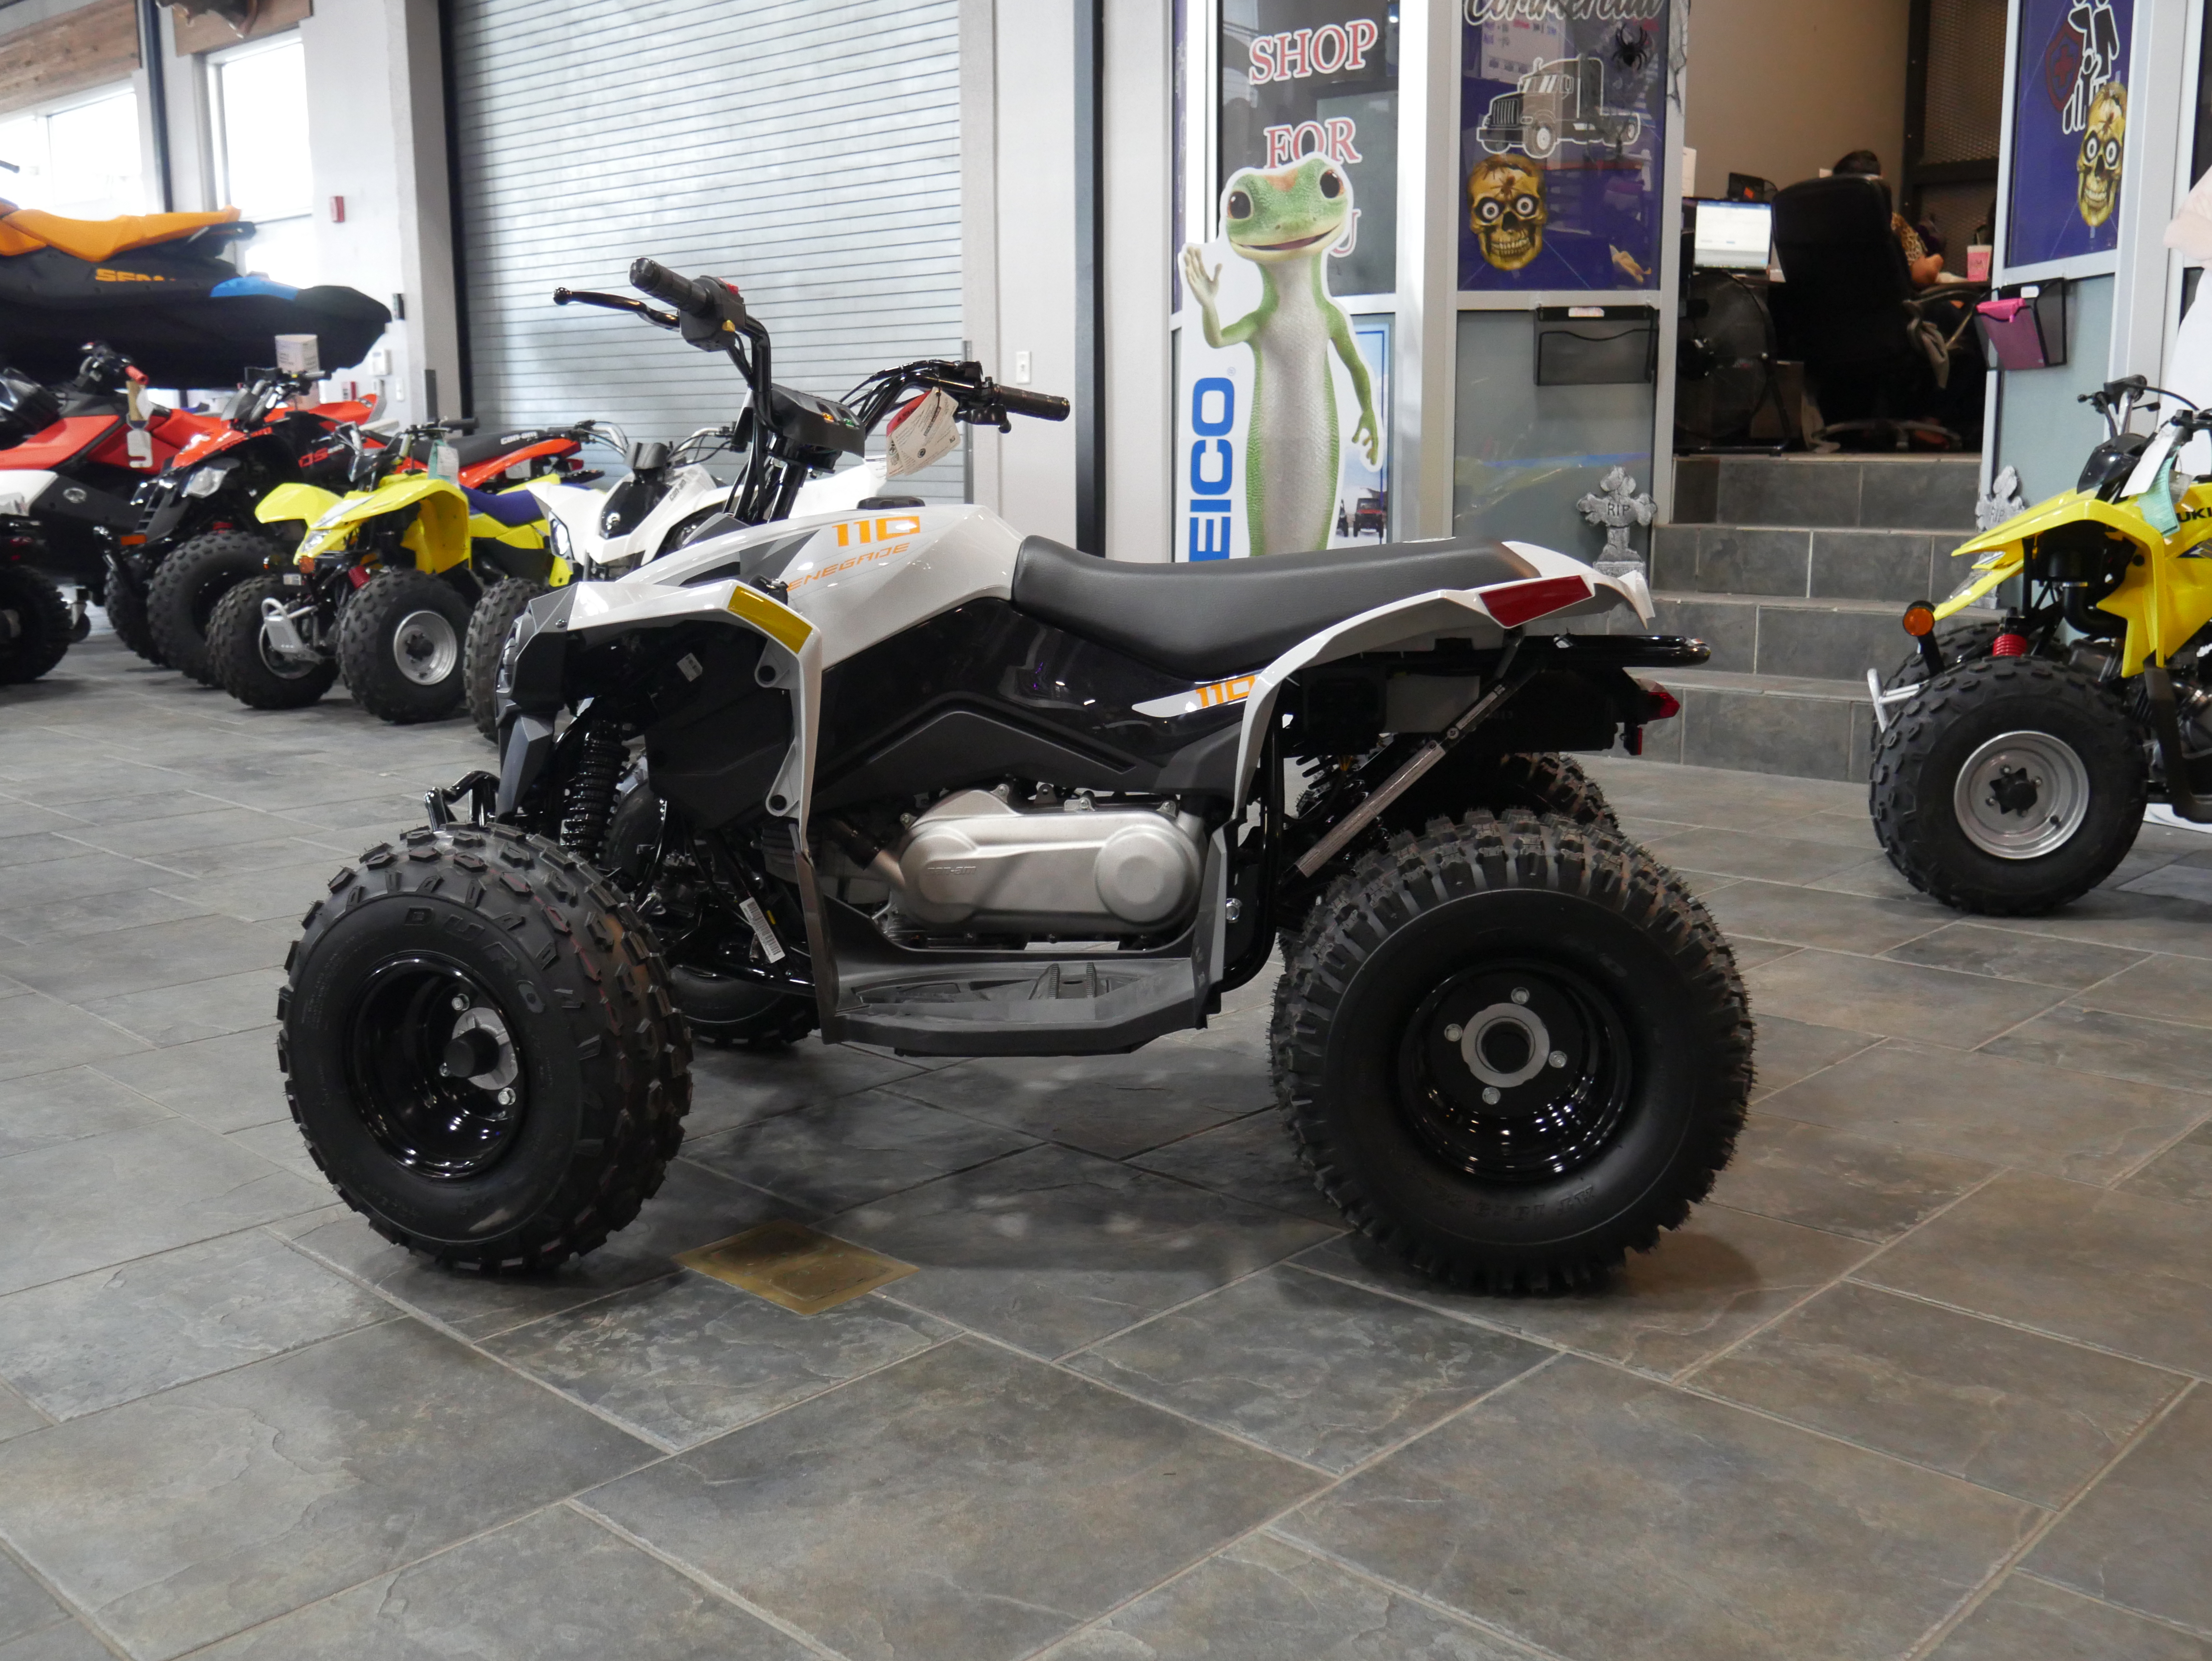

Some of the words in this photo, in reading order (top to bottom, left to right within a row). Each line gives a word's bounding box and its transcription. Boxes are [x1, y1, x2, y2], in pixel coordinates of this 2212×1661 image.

[1249, 19, 1378, 85] SHOP
[1264, 117, 1362, 170] FOR
[1189, 378, 1234, 561] EICO
[1607, 502, 1630, 516] RIP
[2176, 506, 2212, 523] UKI
[832, 516, 921, 547] 110
[786, 542, 910, 592] ENEGADE
[1196, 675, 1255, 708] 110
